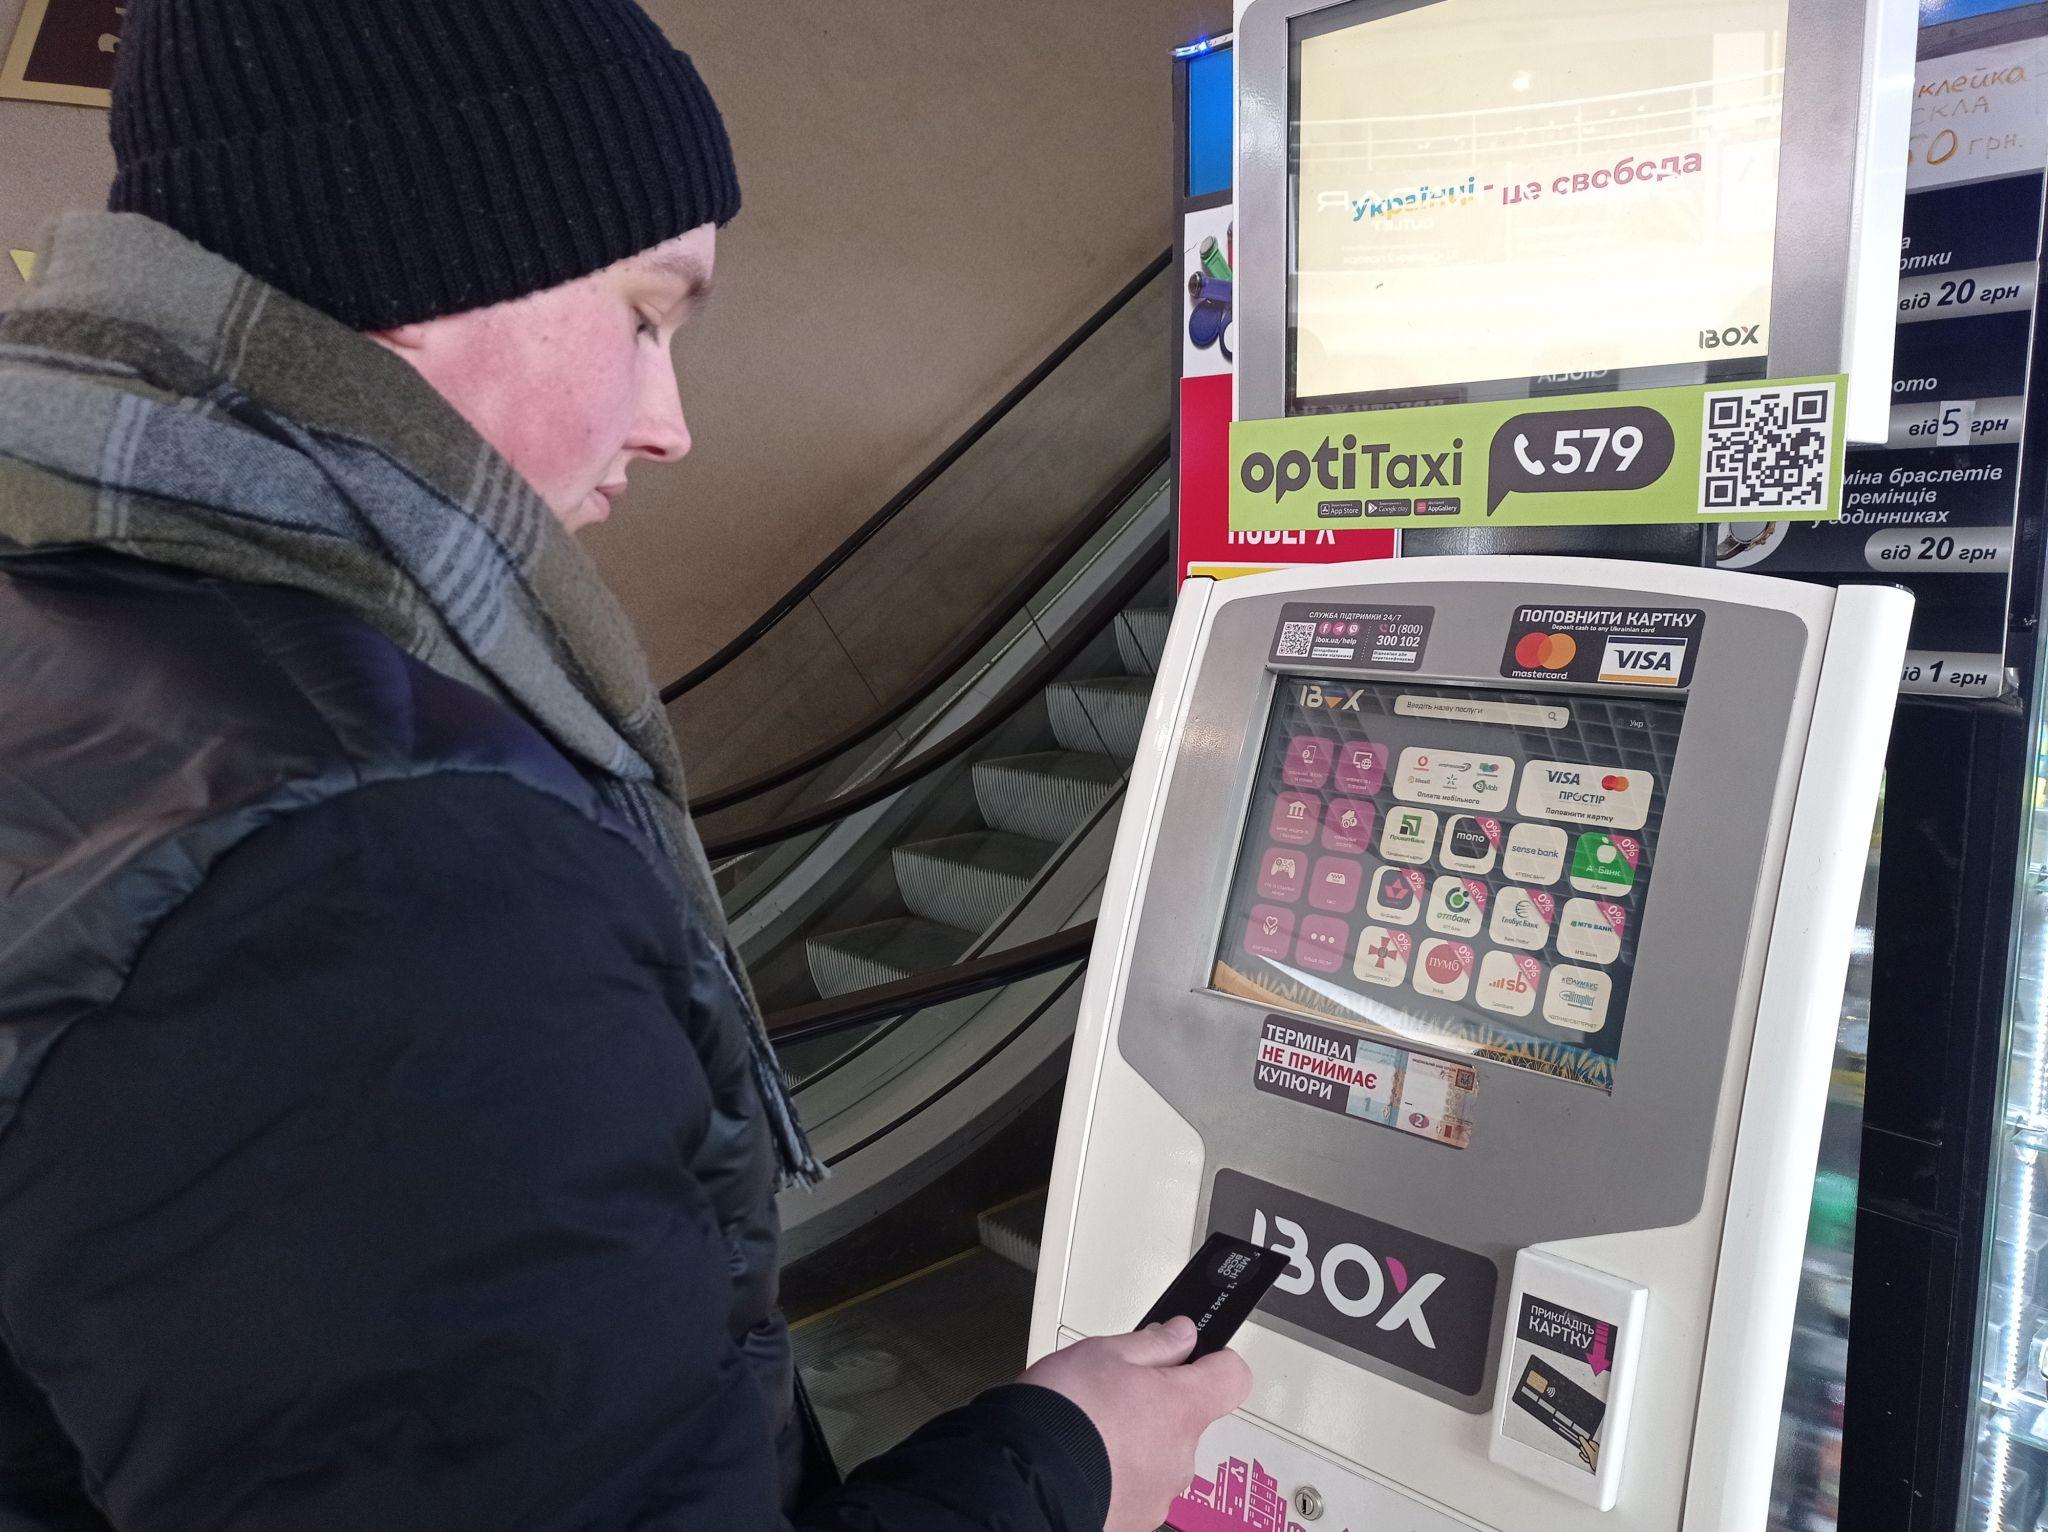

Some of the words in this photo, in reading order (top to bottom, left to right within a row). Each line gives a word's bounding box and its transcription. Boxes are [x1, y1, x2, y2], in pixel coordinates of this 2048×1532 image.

[1918, 66, 2026, 98] клейка
[1502, 180, 1542, 206] це
[1552, 151, 1703, 195] свобода
[1899, 251, 1952, 271] отки
[1899, 292, 1931, 311] від
[1936, 278, 1976, 307] 20
[1980, 284, 2020, 304] грн
[1698, 323, 1760, 350] IBOX
[1892, 377, 1938, 392] ото
[1908, 419, 1939, 436] від
[1942, 407, 1962, 436] 5
[1970, 417, 2009, 435] грн
[1551, 425, 1645, 475] 579
[1842, 469, 1883, 486] міна
[1889, 464, 2004, 487] браслетів
[1846, 488, 1938, 509] ремінців
[1330, 507, 1342, 515] App
[1427, 504, 1458, 513] AppGallery
[1880, 544, 1912, 560] від
[1917, 536, 1955, 560] 20
[1958, 548, 1998, 564] грн
[1308, 611, 1338, 619] СЛУЖБА
[1339, 612, 1382, 621] ПІДТРИМКИ
[1382, 614, 1402, 622] 24/7
[1519, 608, 1623, 626] ПОПОВНИТИ
[1626, 611, 1697, 628] КАРТКУ
[1389, 623, 1396, 634] 0
[1396, 624, 1424, 636] (800)
[1551, 623, 1574, 632] Deposit
[1314, 636, 1358, 646] ibox.ua/help
[1376, 635, 1397, 646] 300
[1400, 636, 1421, 647] 102
[1612, 649, 1671, 671] VISA
[1511, 669, 1569, 680] mastercard
[1901, 667, 1921, 682] ід
[1929, 660, 1945, 683] 1
[1949, 673, 1989, 687] грн
[1545, 769, 1580, 785] VISA
[1559, 791, 1606, 804] ПРОСТІР
[1545, 807, 1586, 818] Поповнити
[1586, 813, 1614, 823] картку
[1456, 831, 1485, 843] mono
[1486, 820, 1500, 837] 0%
[1511, 845, 1536, 855] sense
[1536, 849, 1559, 858] bank
[1621, 838, 1639, 857] 0%
[1467, 881, 1485, 903] NEW
[1537, 893, 1554, 912] 0%
[1608, 905, 1625, 924] 0%
[1397, 933, 1411, 951] 0%
[1458, 945, 1473, 963] 0%
[1524, 958, 1540, 978] 0%
[1506, 971, 1528, 993] sb
[1266, 1023, 1353, 1062] ТЕРМІНАЛ
[1262, 1044, 1286, 1064] НЕ
[1288, 1050, 1378, 1090] ПРИЙМАЄ
[1258, 1064, 1334, 1100] КУПЮРИ
[1364, 1096, 1372, 1112] 1
[1414, 1114, 1425, 1127] 2
[1250, 1207, 1446, 1350] IBOX
[1530, 1304, 1595, 1335] ПРИКЛАДІТЬ
[1528, 1315, 1594, 1349] КАРТКУ
